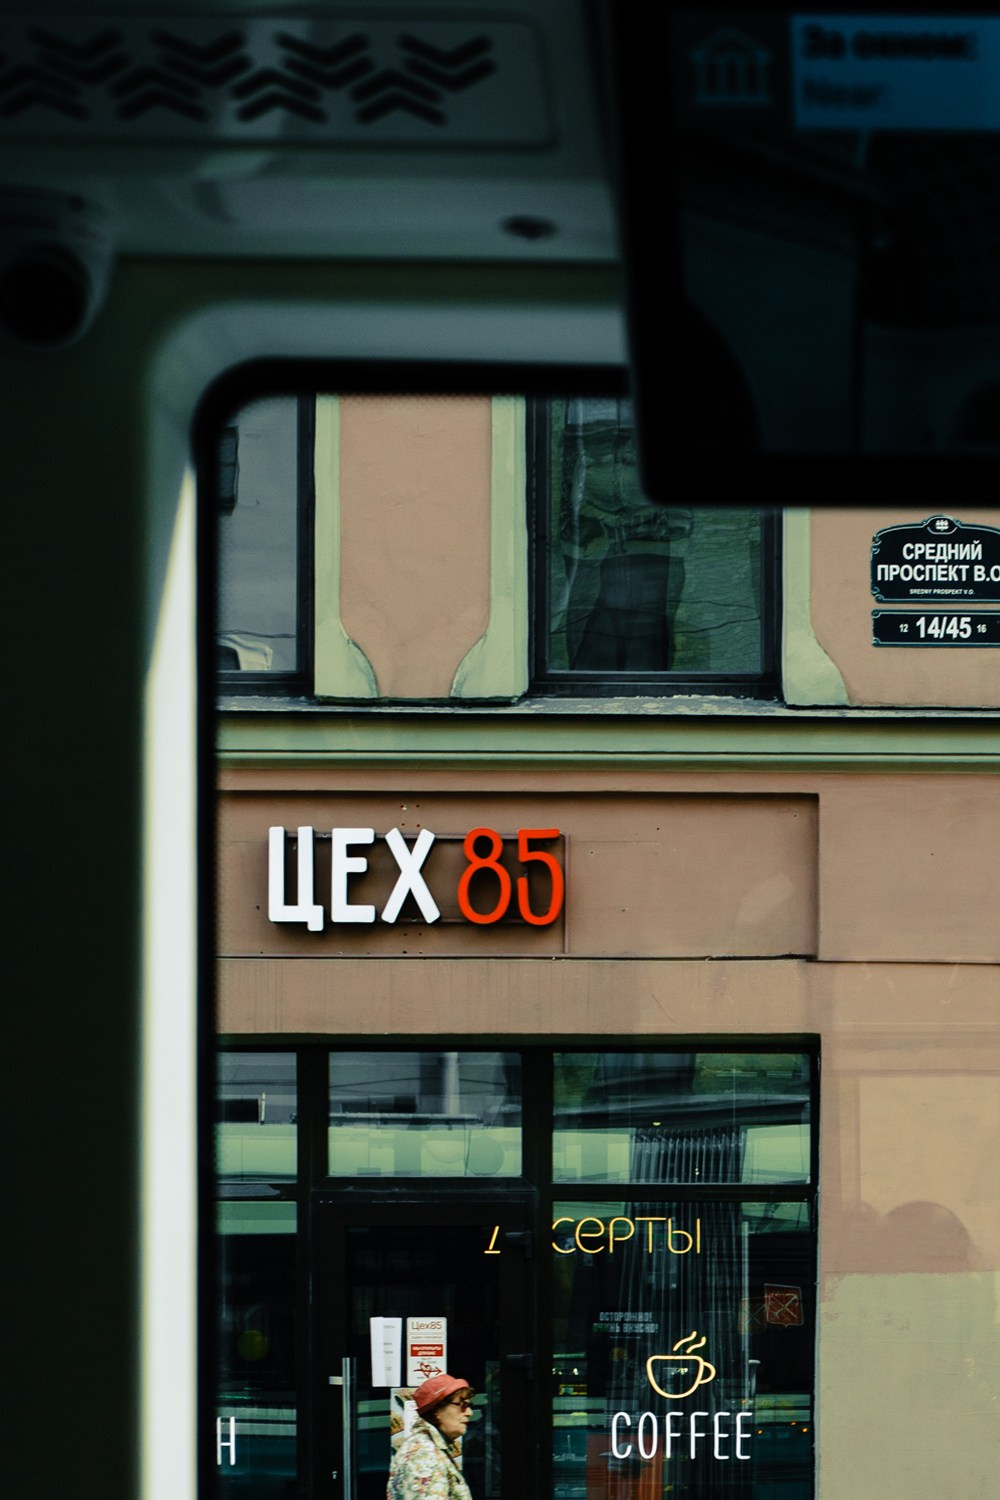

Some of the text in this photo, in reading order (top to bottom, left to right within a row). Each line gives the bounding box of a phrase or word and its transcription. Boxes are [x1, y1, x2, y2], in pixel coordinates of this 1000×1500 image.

[902, 540, 982, 563] СРЕДНИЙ
[877, 564, 969, 581] ПРОСПЕКТ
[899, 623, 909, 633] 12
[916, 616, 972, 639] 14/45
[268, 826, 564, 931] ЦЕХ 85
[611, 1411, 753, 1460] COFFEE
